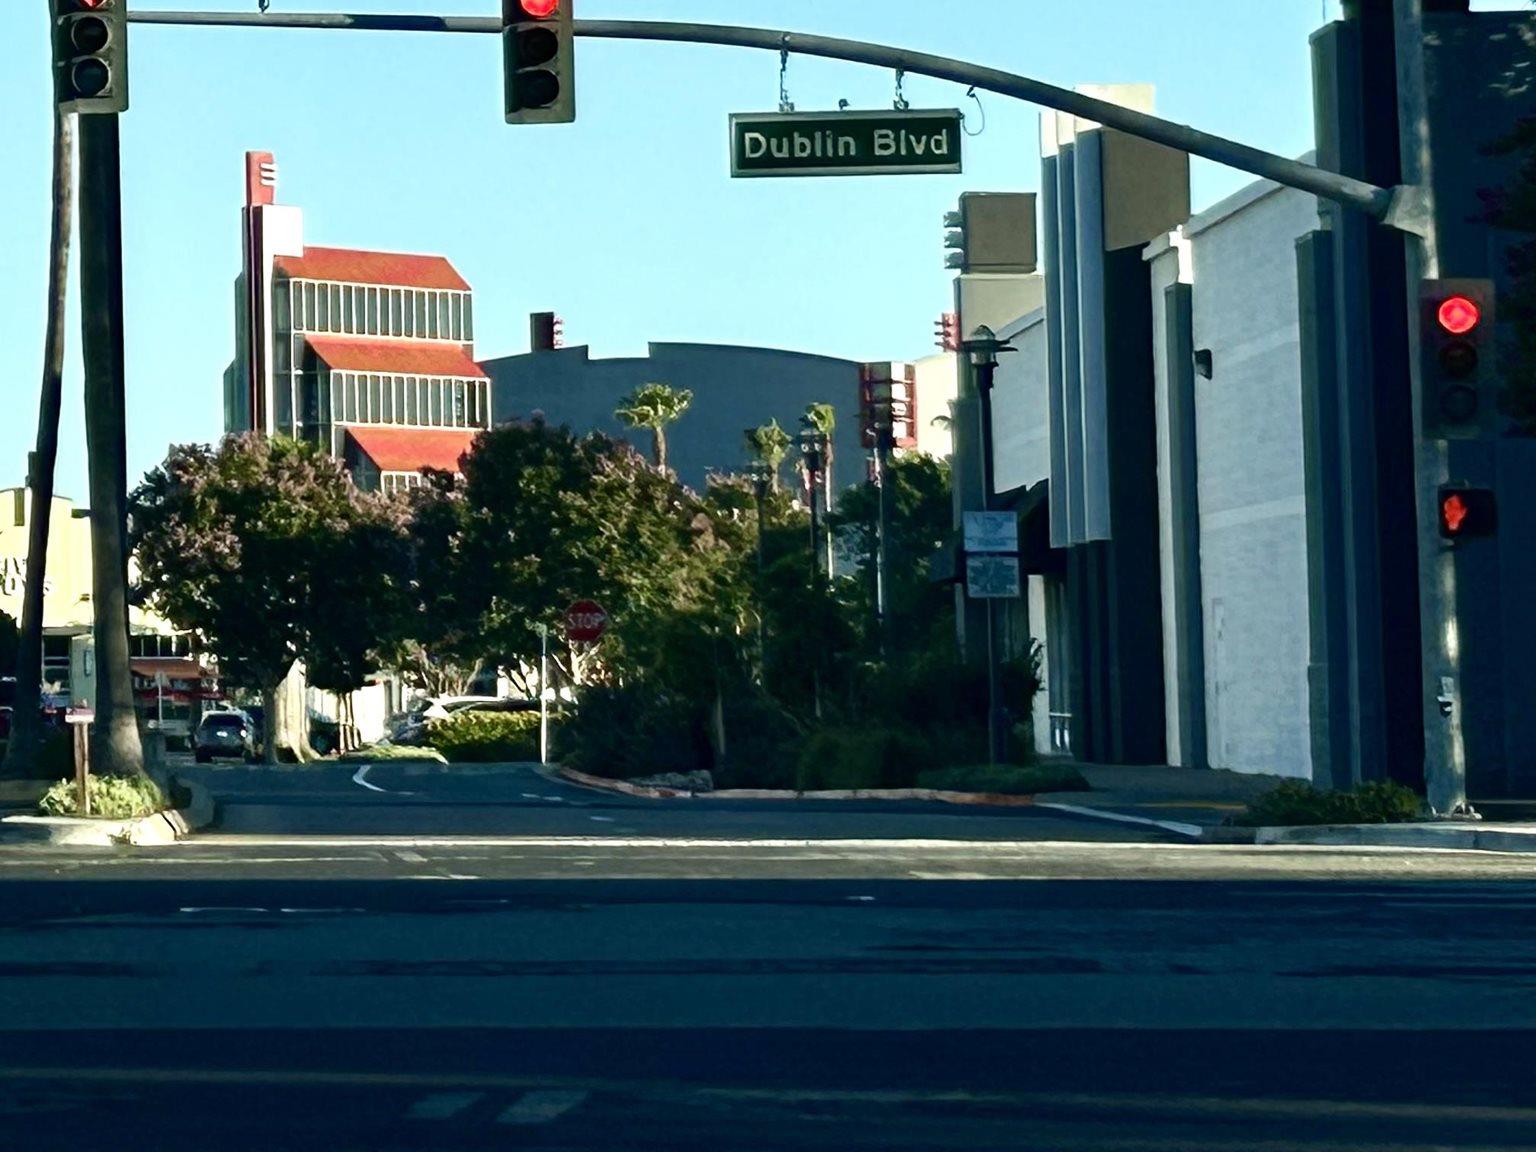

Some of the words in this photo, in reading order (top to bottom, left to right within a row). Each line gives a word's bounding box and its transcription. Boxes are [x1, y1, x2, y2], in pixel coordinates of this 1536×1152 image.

[744, 130, 856, 159] Dublin
[873, 128, 948, 157] Blvd
[567, 612, 603, 629] STOP
